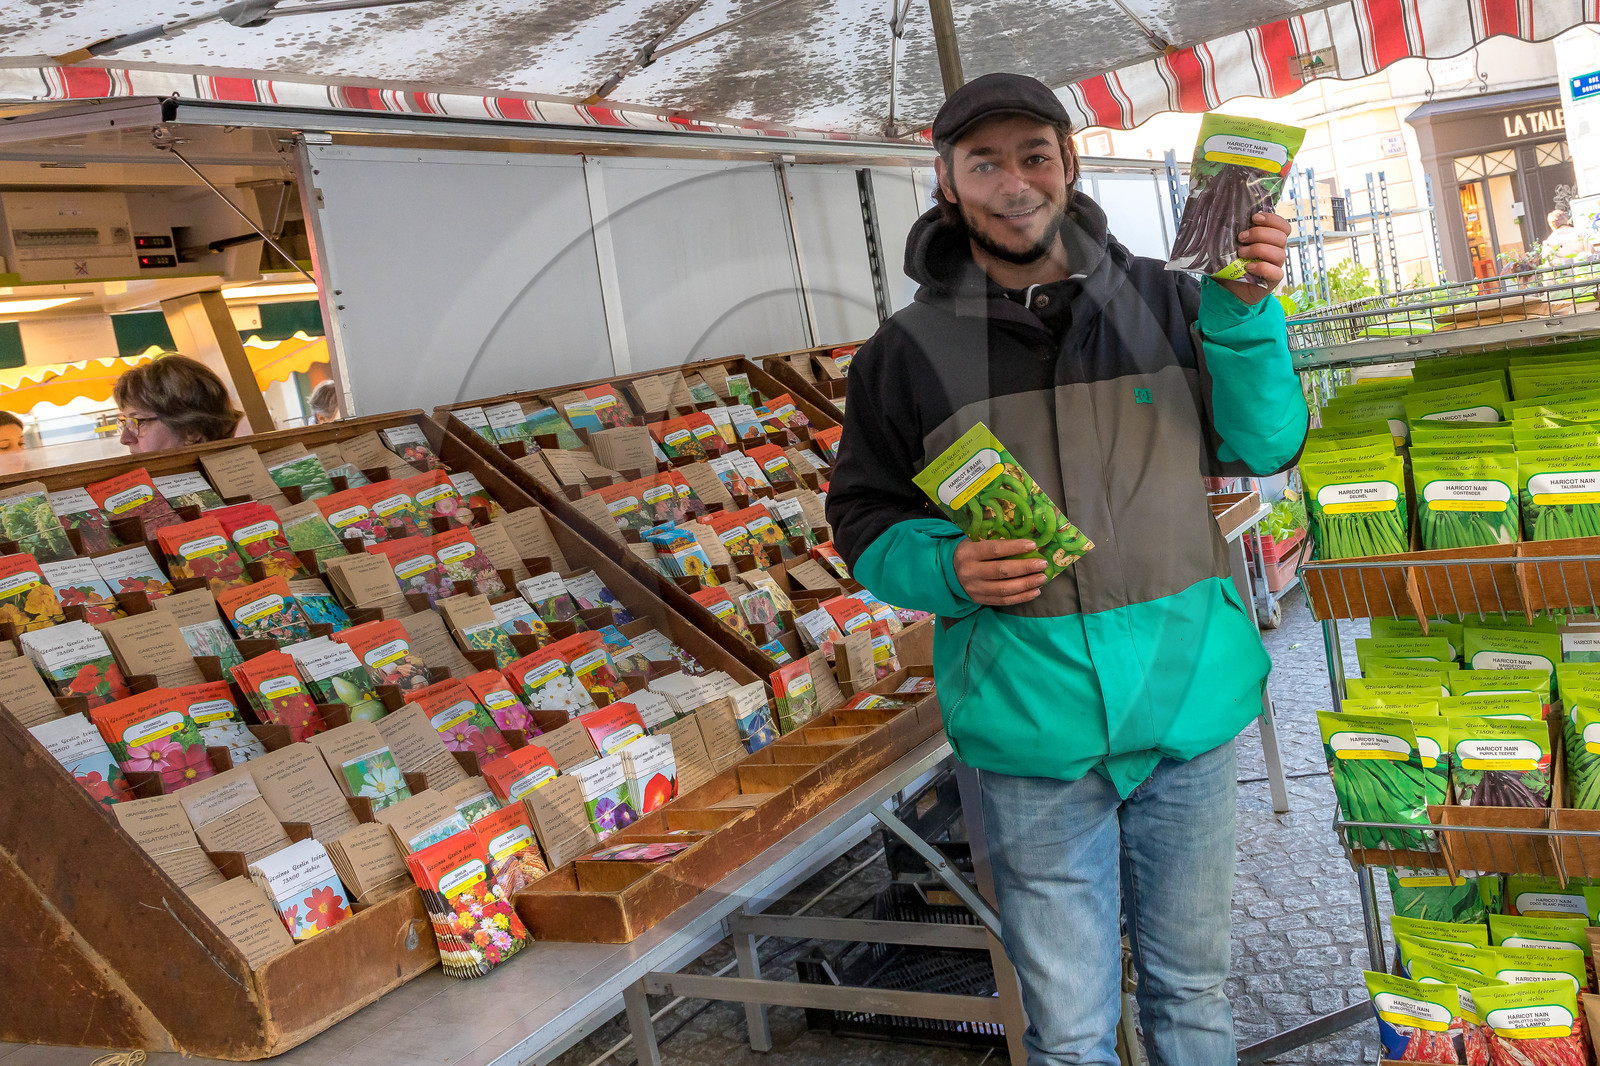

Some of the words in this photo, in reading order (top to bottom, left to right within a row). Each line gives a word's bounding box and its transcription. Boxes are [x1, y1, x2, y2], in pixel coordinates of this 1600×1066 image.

[1504, 115, 1528, 138] LA
[1227, 141, 1253, 150] HARICOT
[948, 471, 966, 489] HARICOT
[970, 459, 983, 470] RAME
[143, 720, 162, 729] COSMOS
[139, 827, 164, 837] COSMOS
[1394, 1000, 1416, 1010] HARICOT
